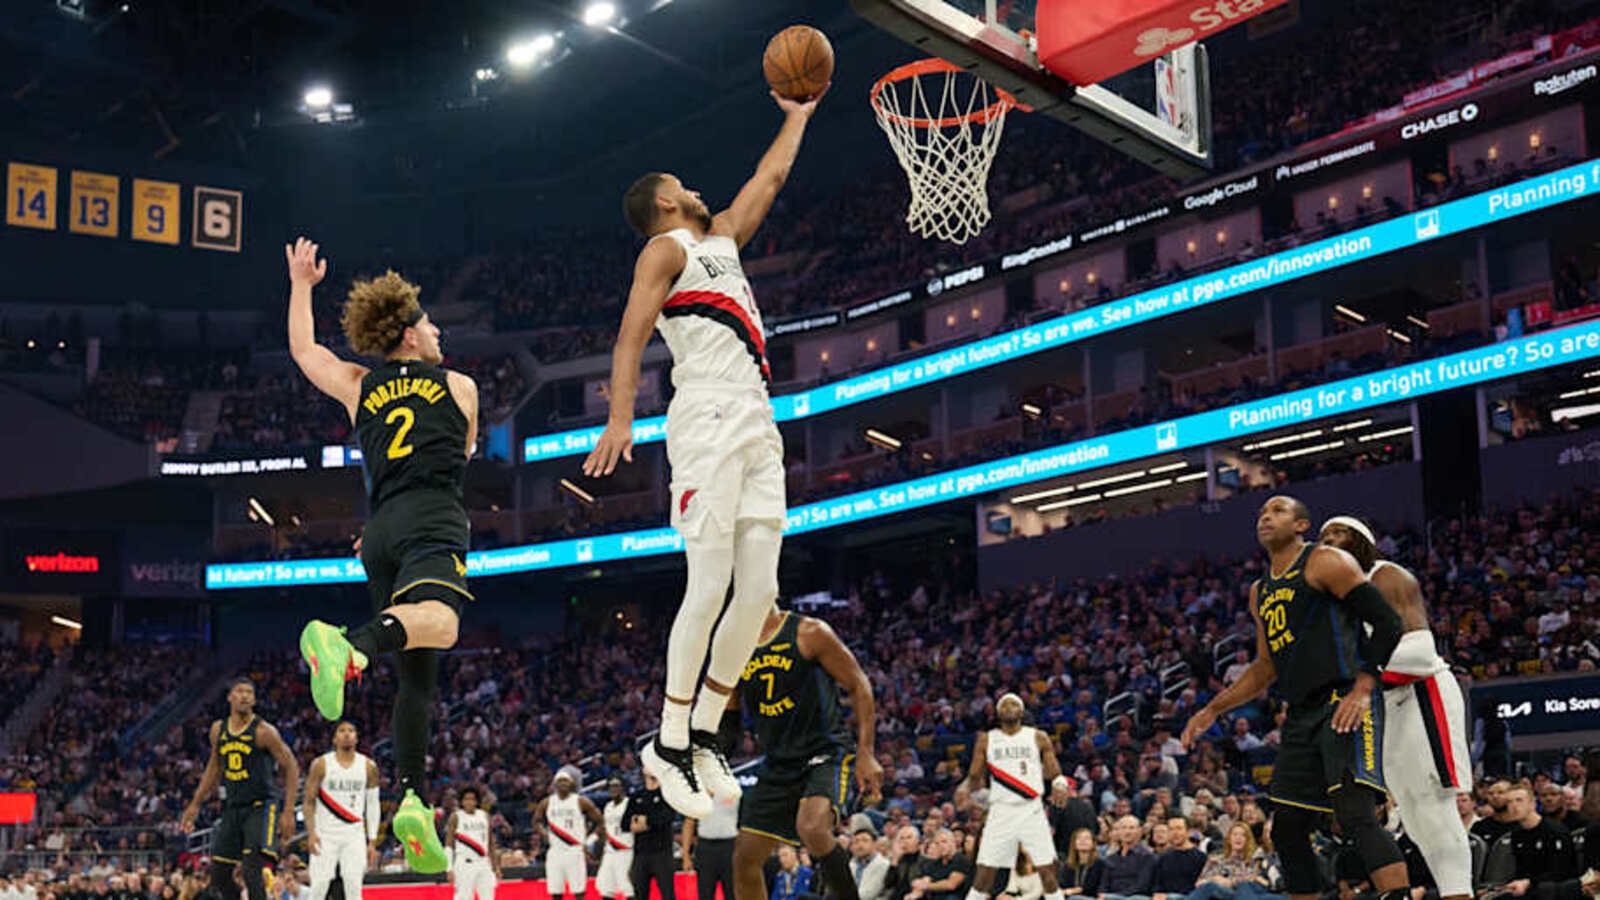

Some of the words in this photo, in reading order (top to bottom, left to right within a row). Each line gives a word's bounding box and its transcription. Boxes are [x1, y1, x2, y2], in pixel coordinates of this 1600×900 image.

[1533, 65, 1597, 95] Rakuten
[1401, 109, 1460, 139] CHASE
[16, 186, 47, 221] 14
[1184, 188, 1224, 210] Google
[1224, 176, 1258, 197] Cloud
[1488, 173, 1586, 215] Planning
[78, 195, 110, 228] 13
[147, 204, 165, 235] 9
[204, 200, 232, 239] 6
[944, 265, 985, 290] PEPSI
[835, 375, 891, 401] Planning
[893, 368, 912, 385] for
[914, 367, 923, 379] a
[925, 352, 966, 373] bright
[968, 334, 1020, 364] future?
[1022, 328, 1041, 348] So
[1044, 324, 1070, 341] are
[1072, 316, 1099, 334] we.
[1102, 305, 1132, 325] See
[1135, 295, 1169, 315] how
[1172, 287, 1189, 304] at
[1193, 235, 1372, 302] pge.com/innovation
[1229, 398, 1313, 430] Planning
[1318, 389, 1347, 409] for
[1351, 386, 1363, 401] a
[1368, 369, 1432, 397] bright
[1437, 346, 1519, 382] future?
[1524, 340, 1555, 362] So
[1560, 332, 1600, 354] are
[385, 406, 415, 460] 2
[200, 461, 241, 476] BUTLER
[811, 507, 828, 523] So
[830, 503, 851, 519] are
[879, 490, 905, 507] See
[907, 484, 938, 502] how
[940, 478, 954, 494] at
[957, 443, 1110, 493] pge.com/innovation
[621, 532, 682, 552] Planning
[26, 551, 99, 572] verizon
[224, 565, 272, 583] future?
[276, 564, 292, 580] So
[295, 567, 316, 579] are
[1265, 603, 1287, 638] 20
[759, 672, 775, 700] 7
[1545, 699, 1568, 713] Kia
[227, 752, 243, 771] 10
